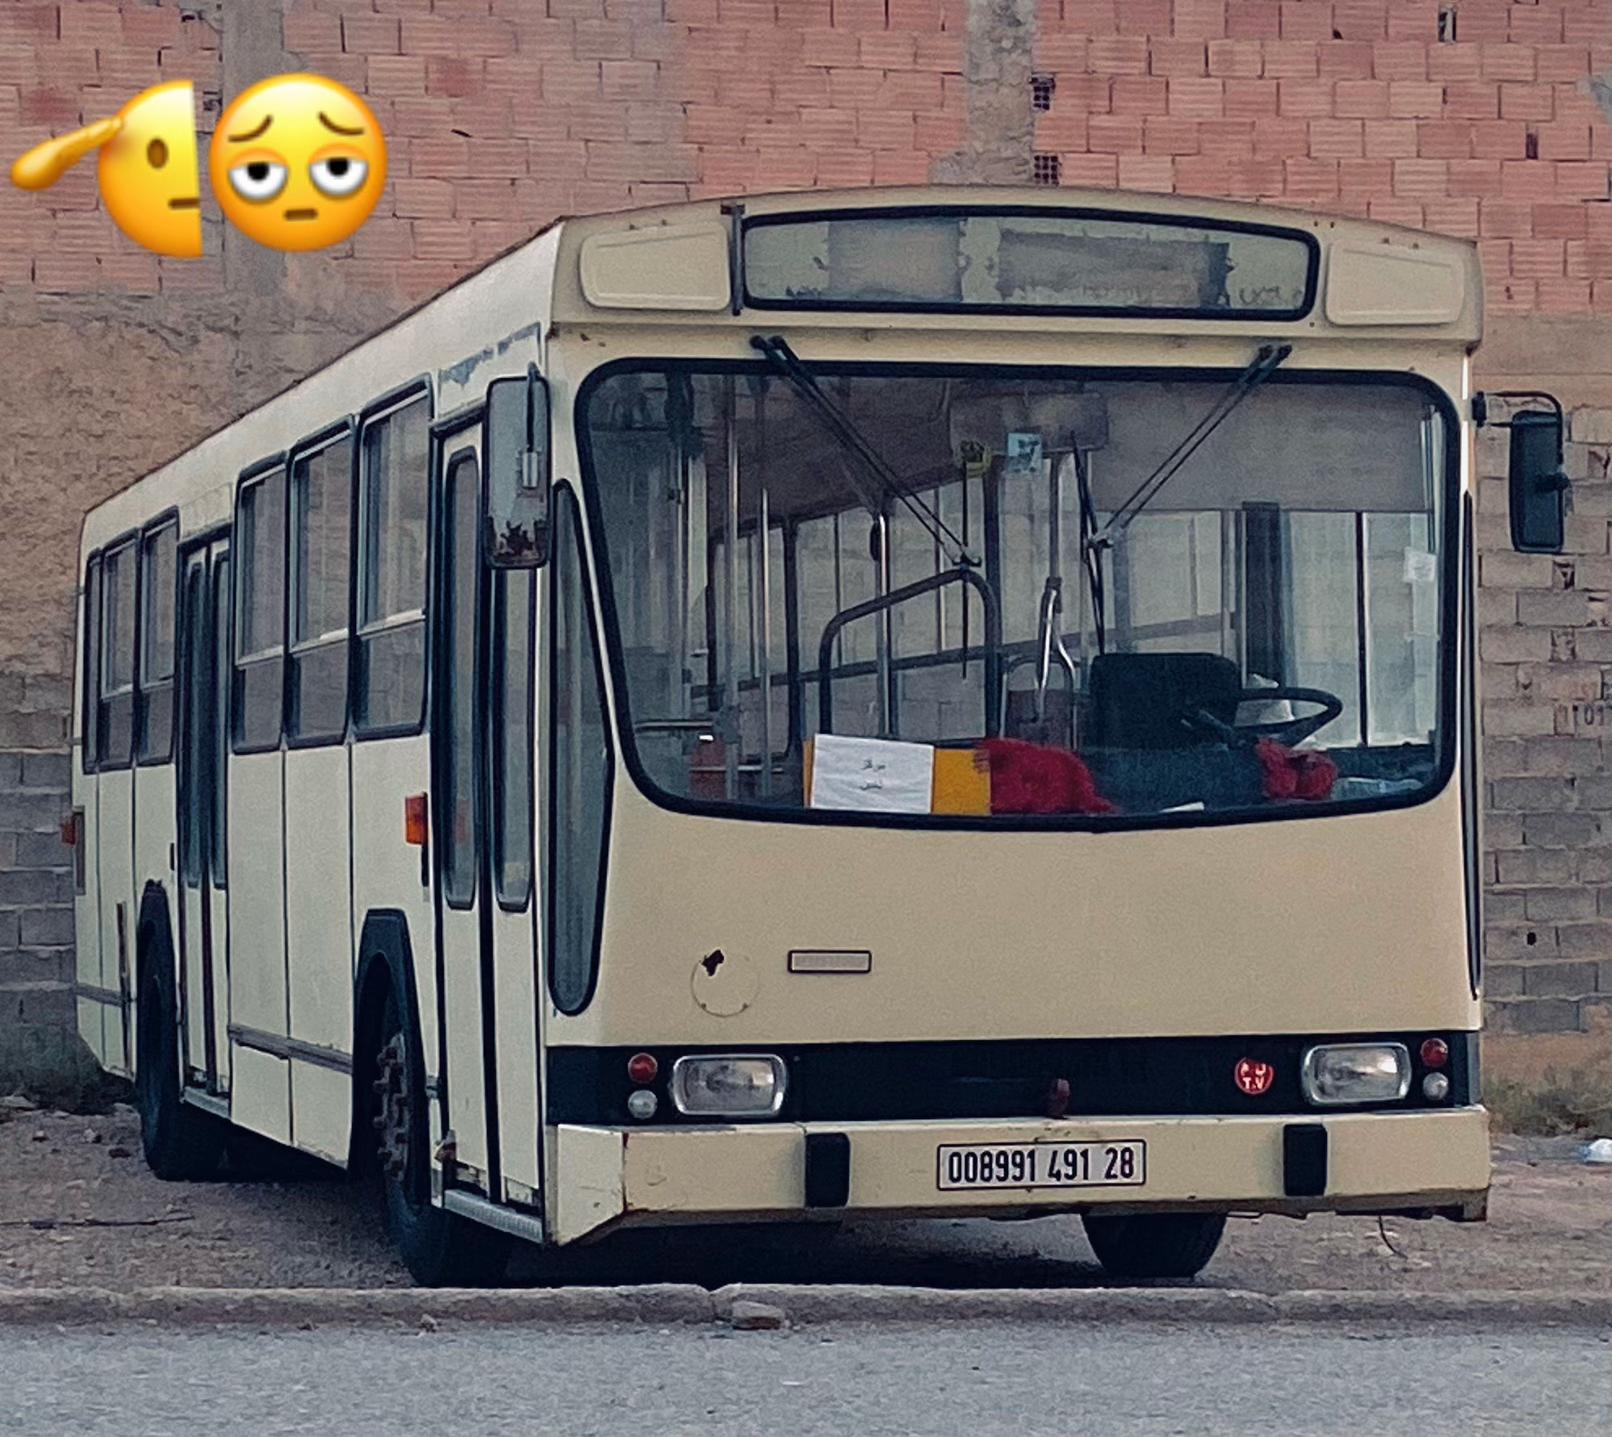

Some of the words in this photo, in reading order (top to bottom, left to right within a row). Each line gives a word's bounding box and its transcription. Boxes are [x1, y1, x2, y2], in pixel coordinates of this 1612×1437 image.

[949, 1149, 1036, 1183] 008991
[1047, 1148, 1089, 1182] 491
[1104, 1146, 1134, 1180] 28
